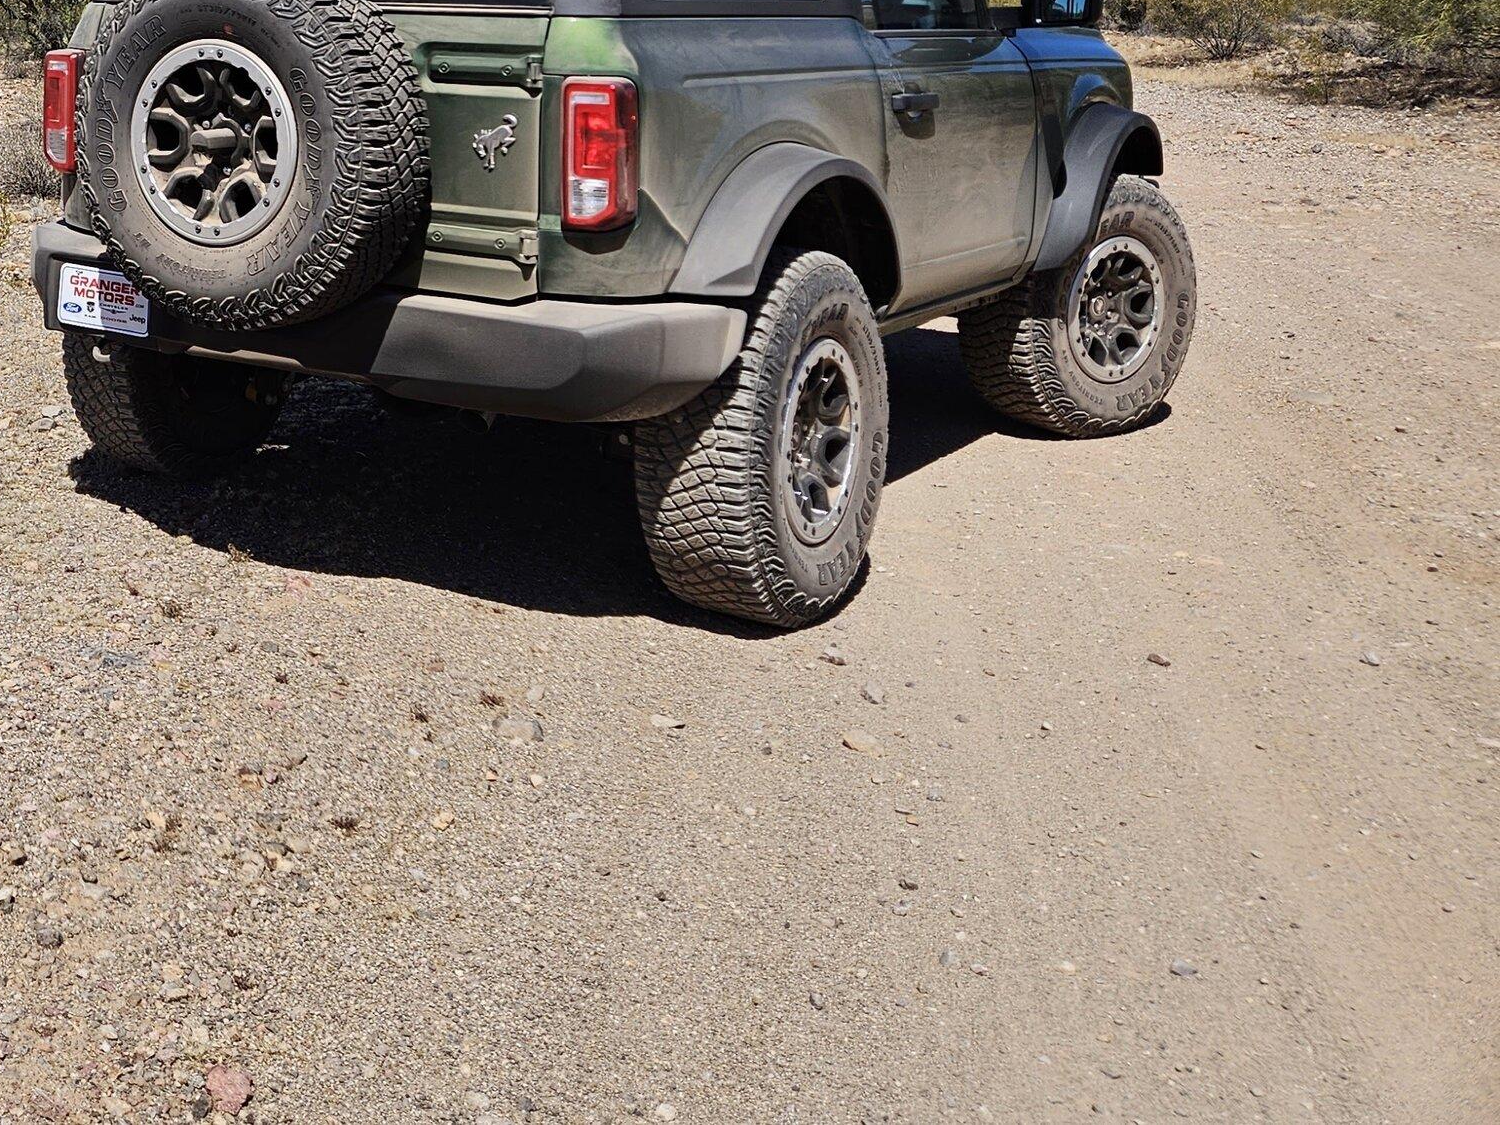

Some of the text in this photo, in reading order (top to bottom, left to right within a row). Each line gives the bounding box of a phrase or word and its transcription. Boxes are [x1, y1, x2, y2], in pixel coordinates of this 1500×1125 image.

[70, 275, 140, 296] GRANGER
[73, 287, 135, 307] MOTORS
[129, 314, 146, 324] Jeep
